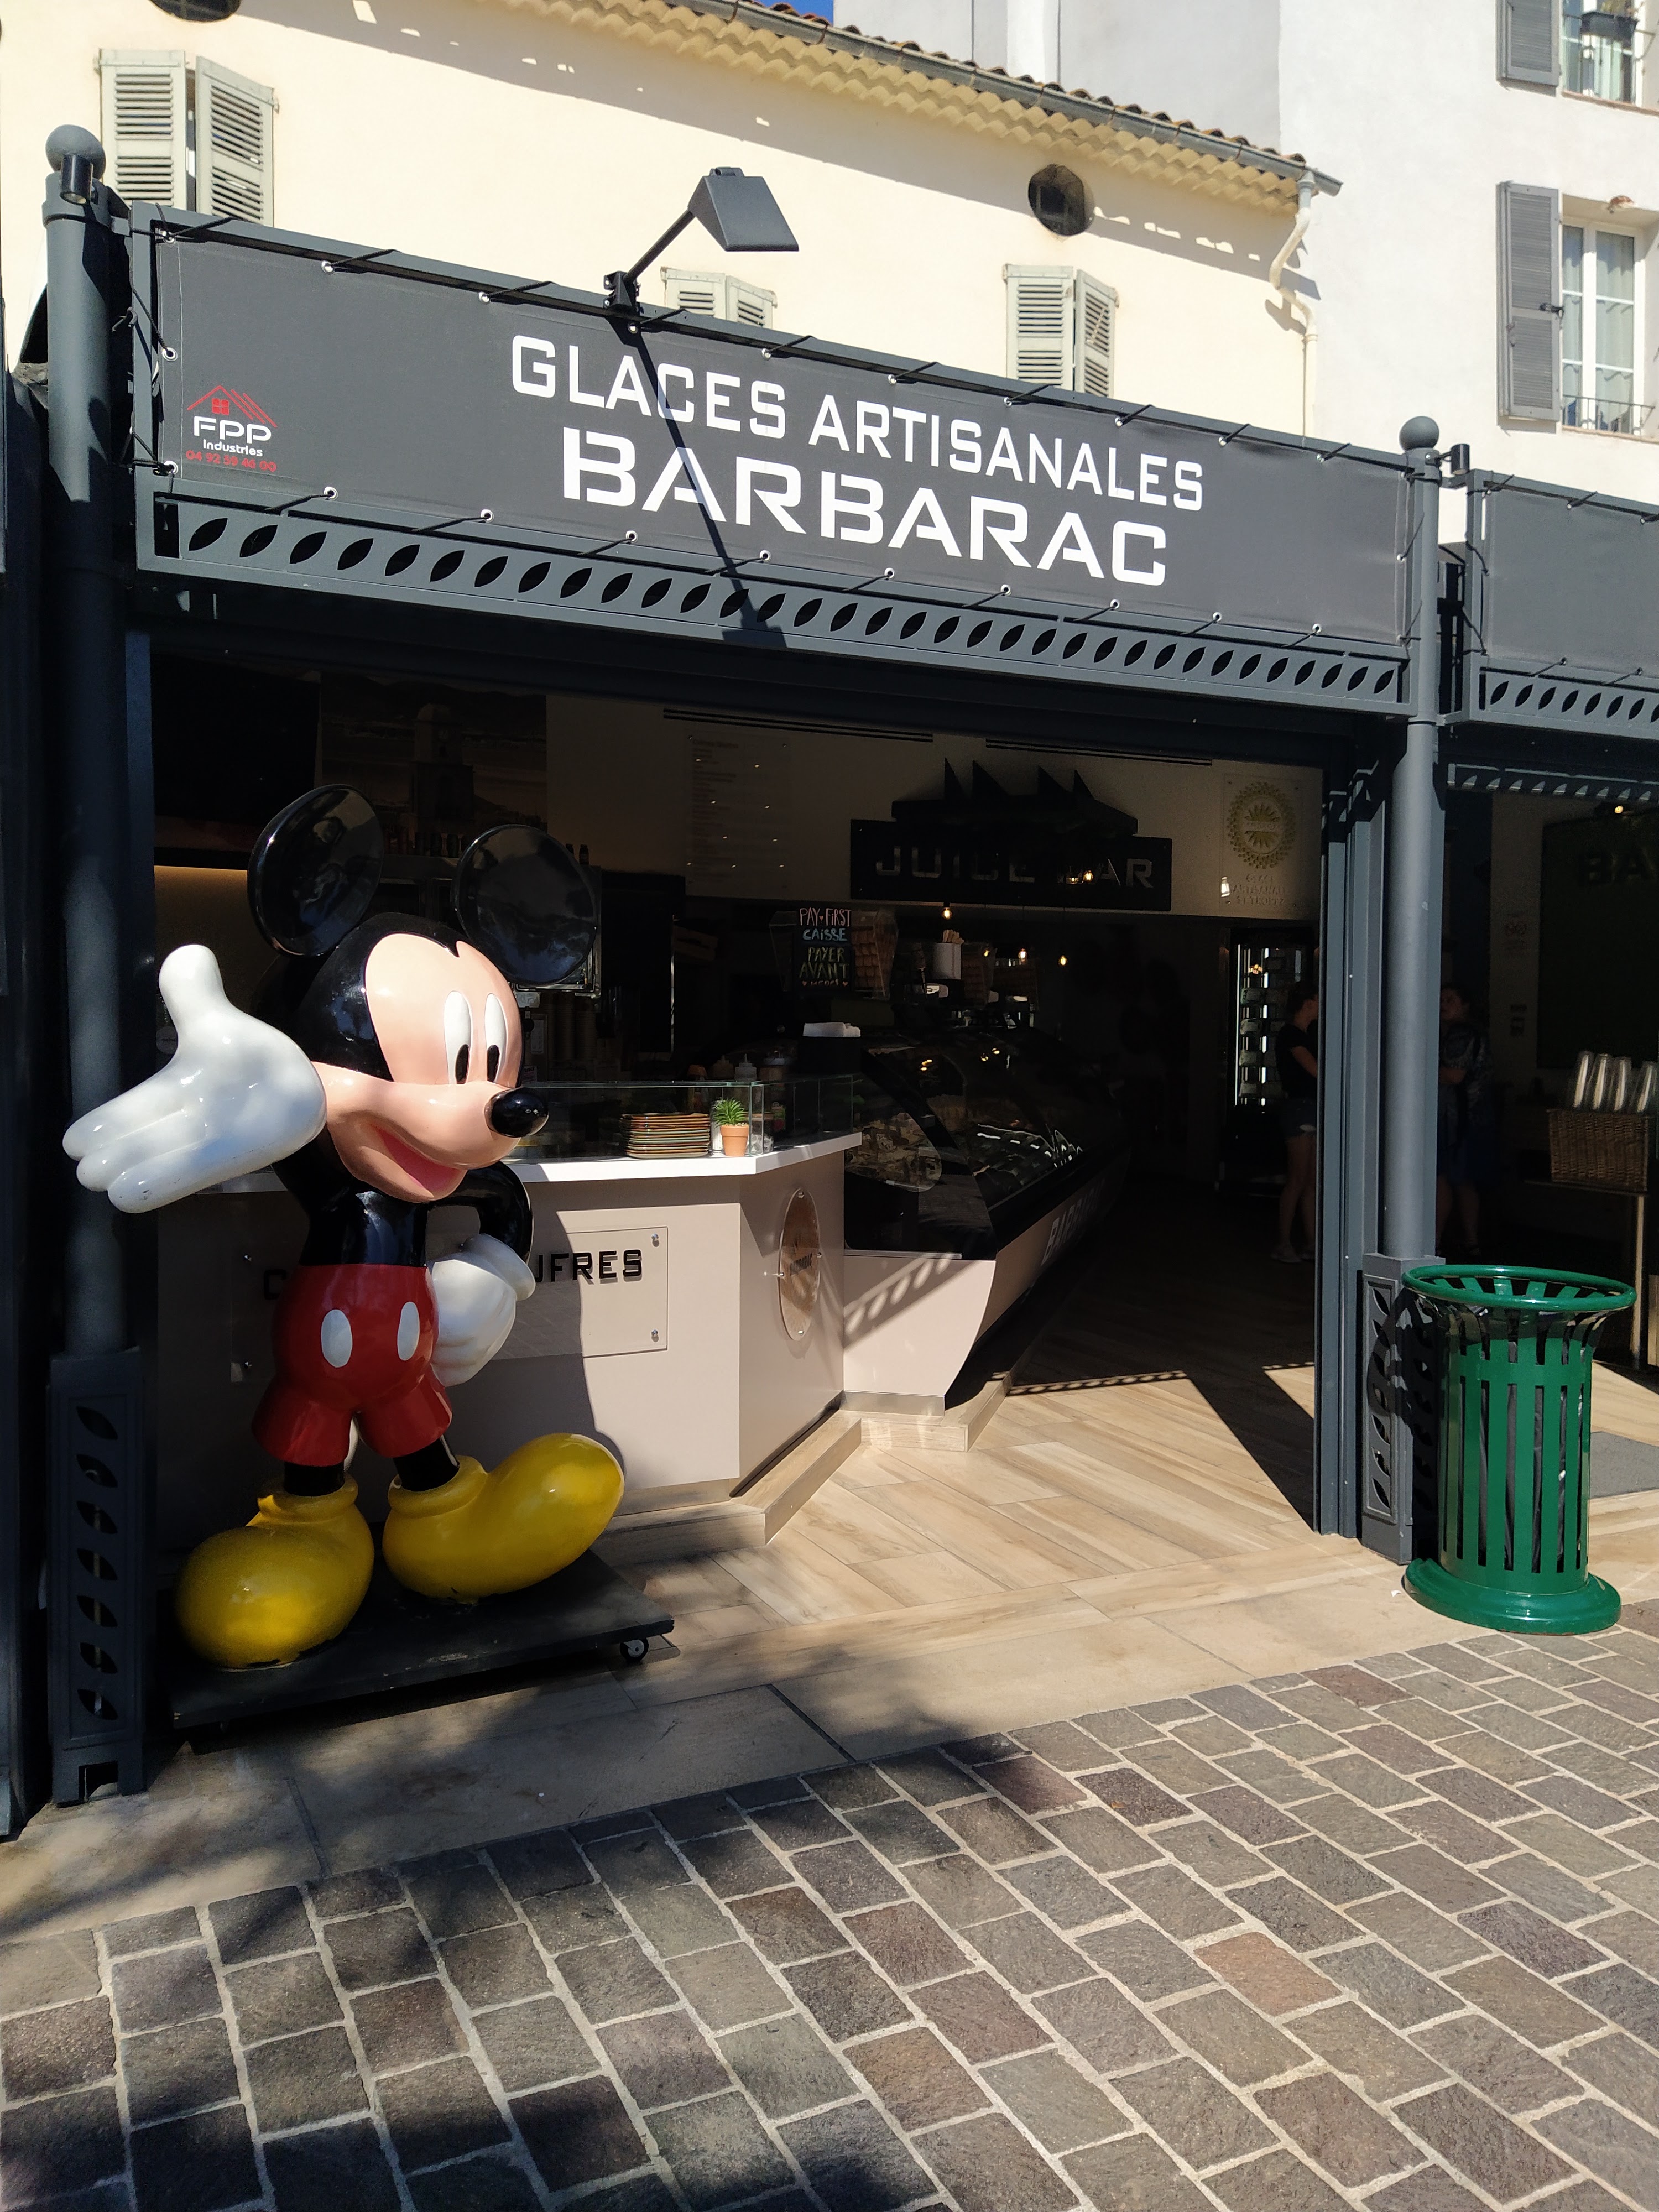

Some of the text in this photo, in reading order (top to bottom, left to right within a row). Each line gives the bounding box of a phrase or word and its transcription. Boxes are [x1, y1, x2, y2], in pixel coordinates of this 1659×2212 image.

[194, 416, 272, 444] FPP
[512, 335, 1203, 511] GLACES ARTISANALES
[203, 439, 263, 457] Industries
[186, 450, 202, 461] 04
[205, 452, 221, 465] 92
[241, 457, 256, 469] 46
[259, 460, 276, 472] 00
[563, 427, 1166, 586] BARBARAC
[1055, 855, 1154, 888] AR
[799, 907, 821, 927] PAY
[807, 946, 845, 962] PAYER
[799, 961, 851, 979] AVANT
[534, 1249, 642, 1283] FRES
